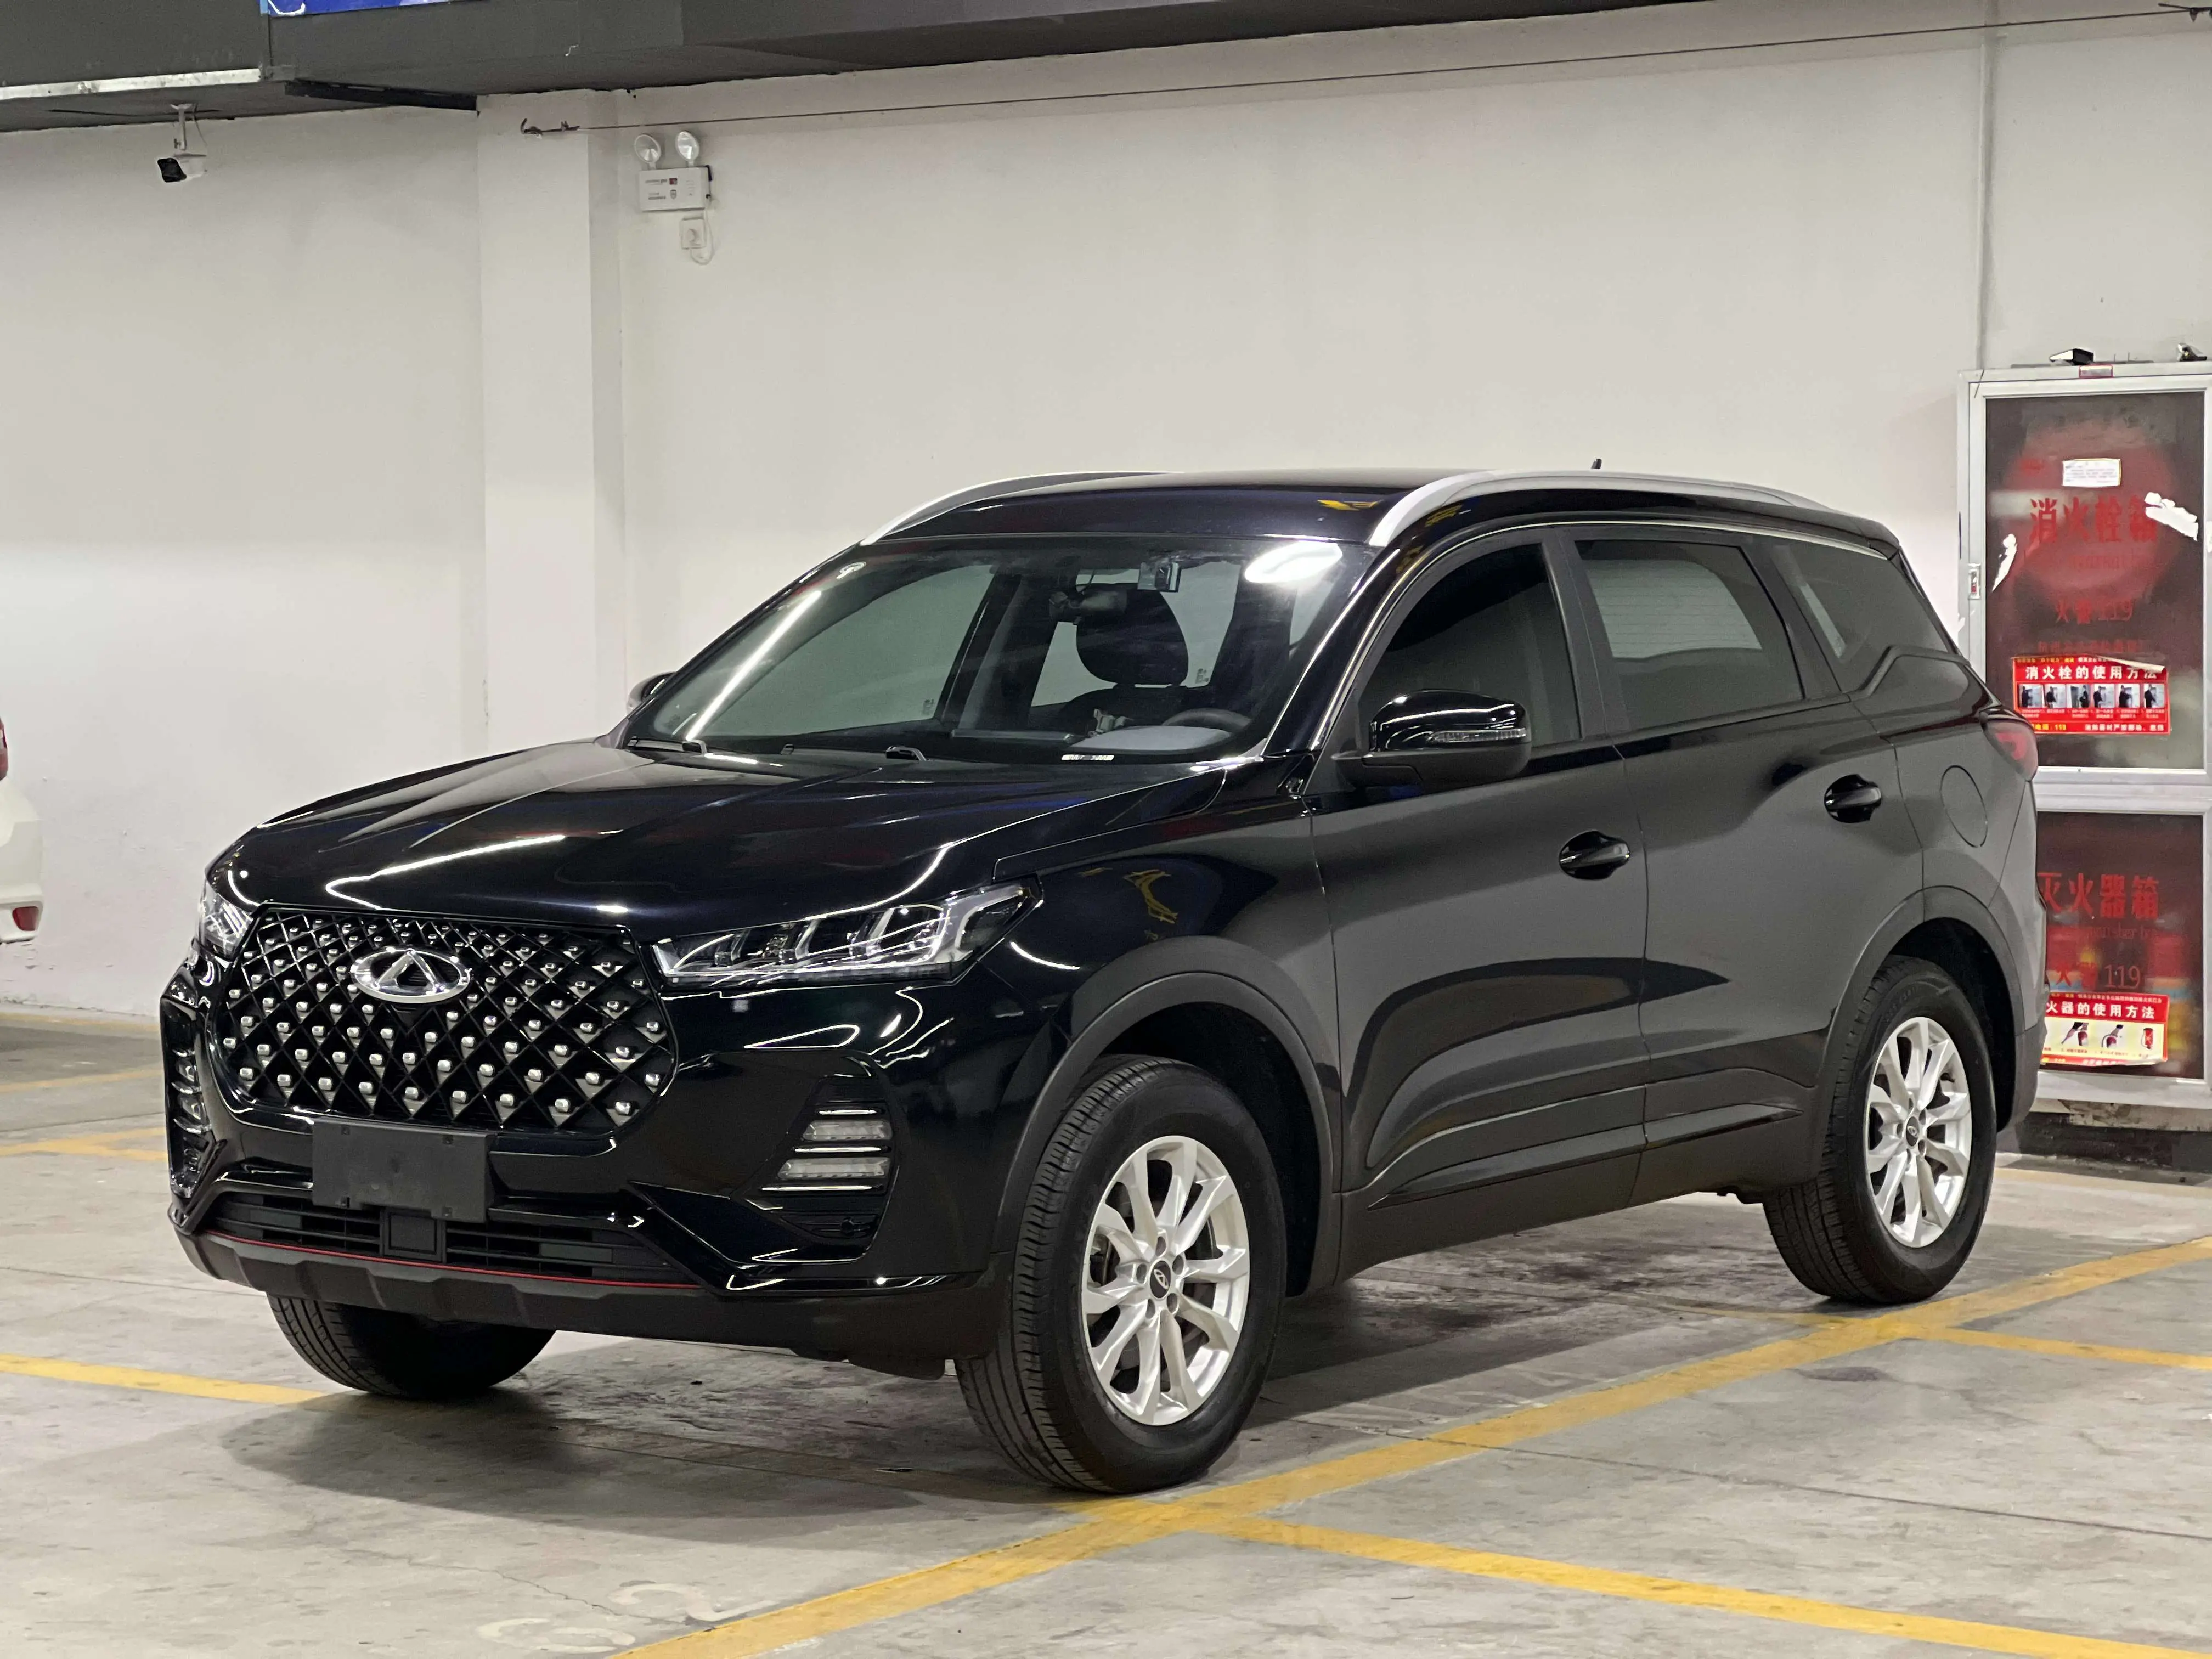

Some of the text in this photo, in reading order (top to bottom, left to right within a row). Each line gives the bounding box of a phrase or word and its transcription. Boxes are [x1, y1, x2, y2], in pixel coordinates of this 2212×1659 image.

[2025, 665, 2157, 680] 消火栓的使用方法
[2037, 873, 2159, 919] 灭火器箱
